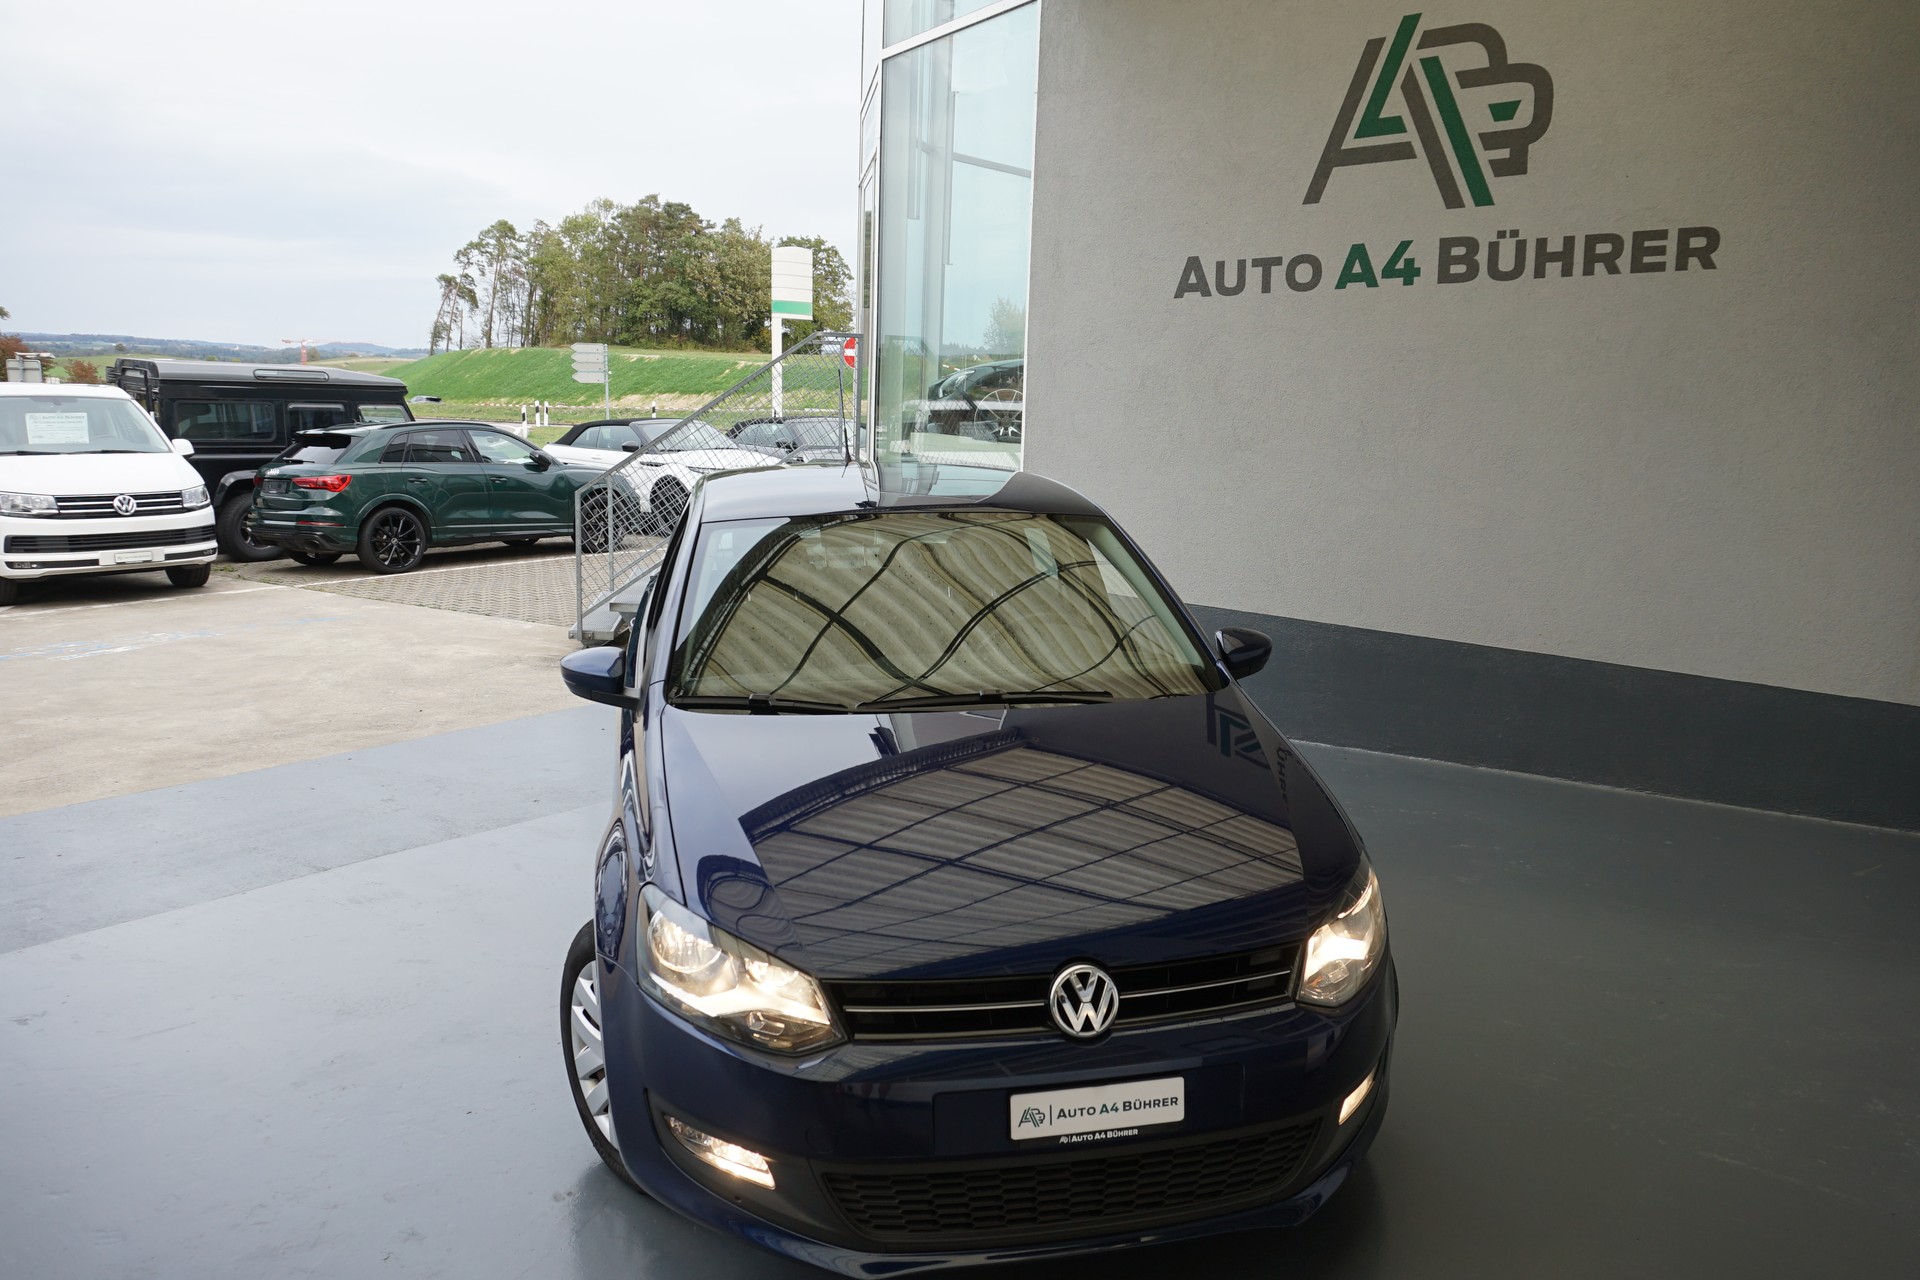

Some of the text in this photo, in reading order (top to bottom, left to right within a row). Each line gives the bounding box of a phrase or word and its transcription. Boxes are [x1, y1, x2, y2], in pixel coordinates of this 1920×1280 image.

[1174, 226, 1721, 299] AUTO A4 BÜHRER
[1050, 964, 1119, 1037] VW
[1057, 1106, 1096, 1120] AUTO
[1099, 1102, 1119, 1115] A4
[1122, 1096, 1179, 1112] BÜHRER
[1071, 1133, 1093, 1143] AUTO
[1094, 1131, 1106, 1140] A4
[1106, 1128, 1138, 1138] BÜHRER
